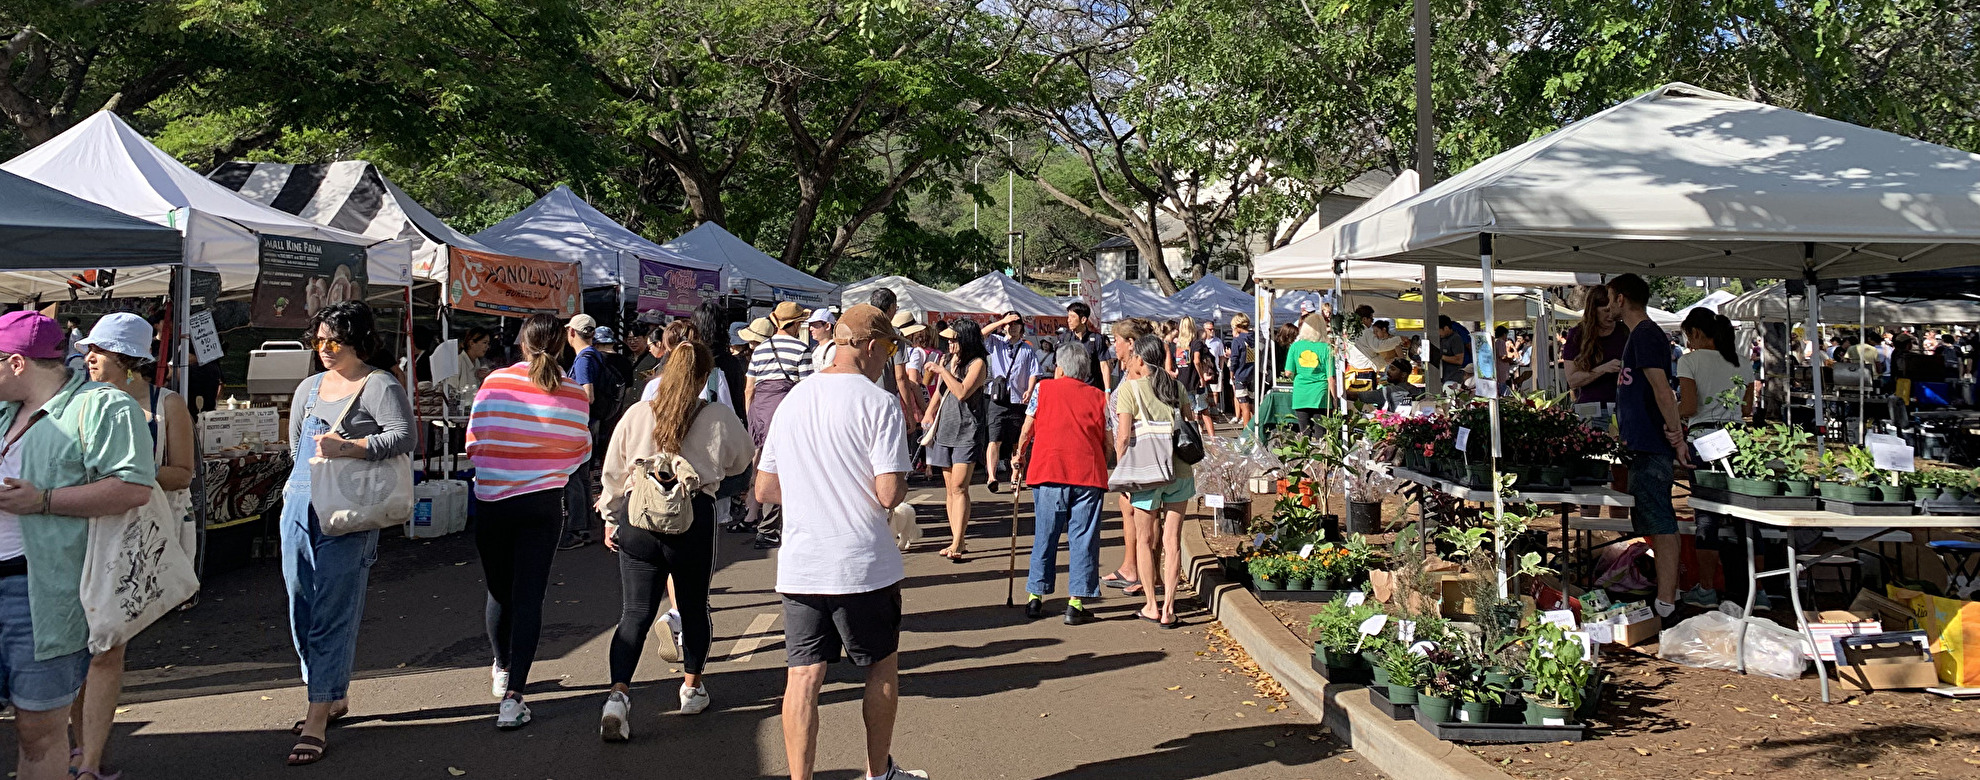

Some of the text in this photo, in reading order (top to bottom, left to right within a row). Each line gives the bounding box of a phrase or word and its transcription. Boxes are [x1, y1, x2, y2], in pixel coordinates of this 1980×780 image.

[286, 240, 302, 252] KINE
[303, 241, 323, 254] FARM
[485, 265, 563, 290] HONOLULU
